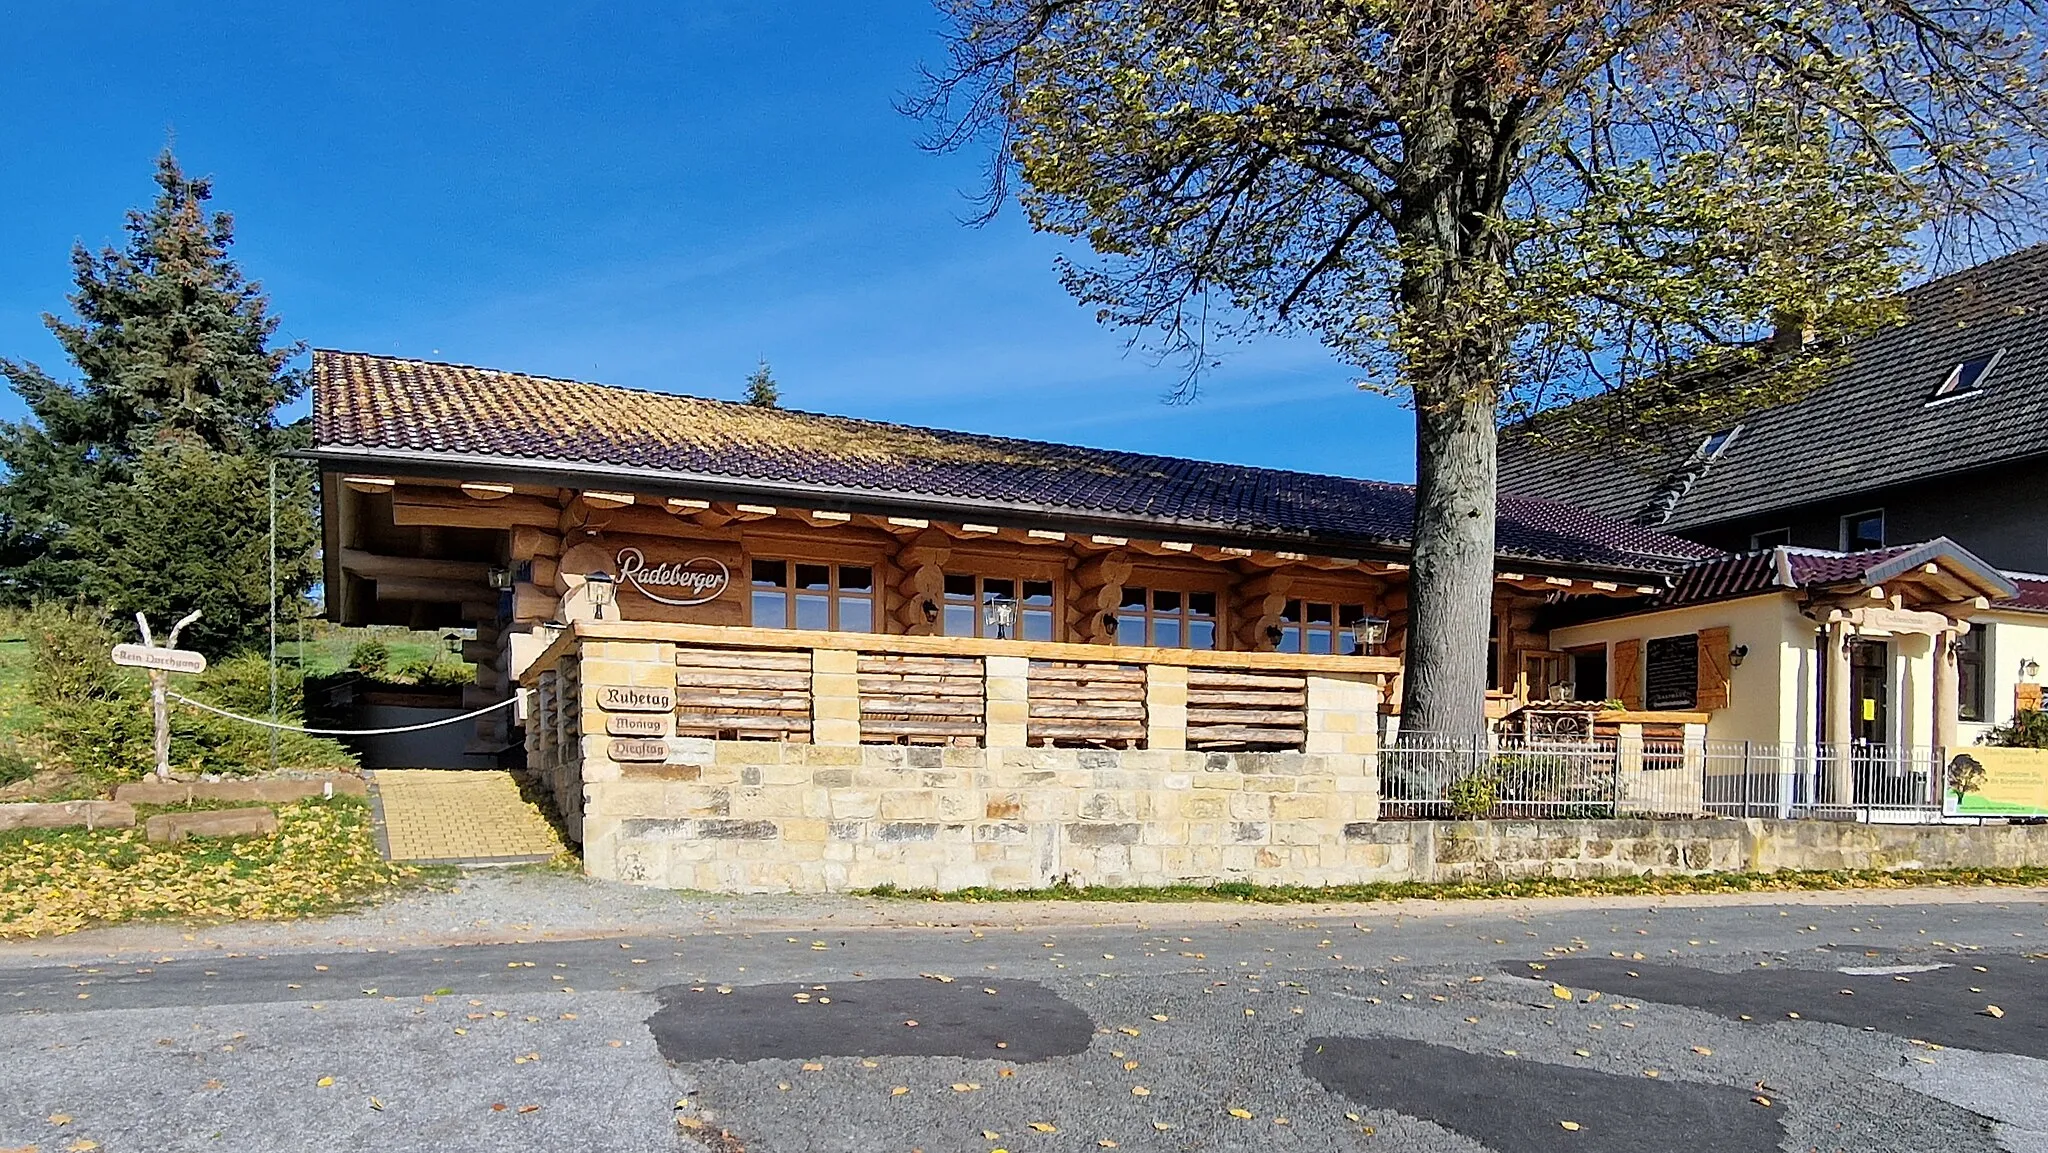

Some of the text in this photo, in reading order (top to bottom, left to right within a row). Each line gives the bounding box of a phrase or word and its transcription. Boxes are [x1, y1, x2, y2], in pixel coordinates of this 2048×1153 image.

[616, 547, 729, 605] Radeberger
[606, 688, 669, 708] Ruhetag
[615, 717, 661, 731] Montag
